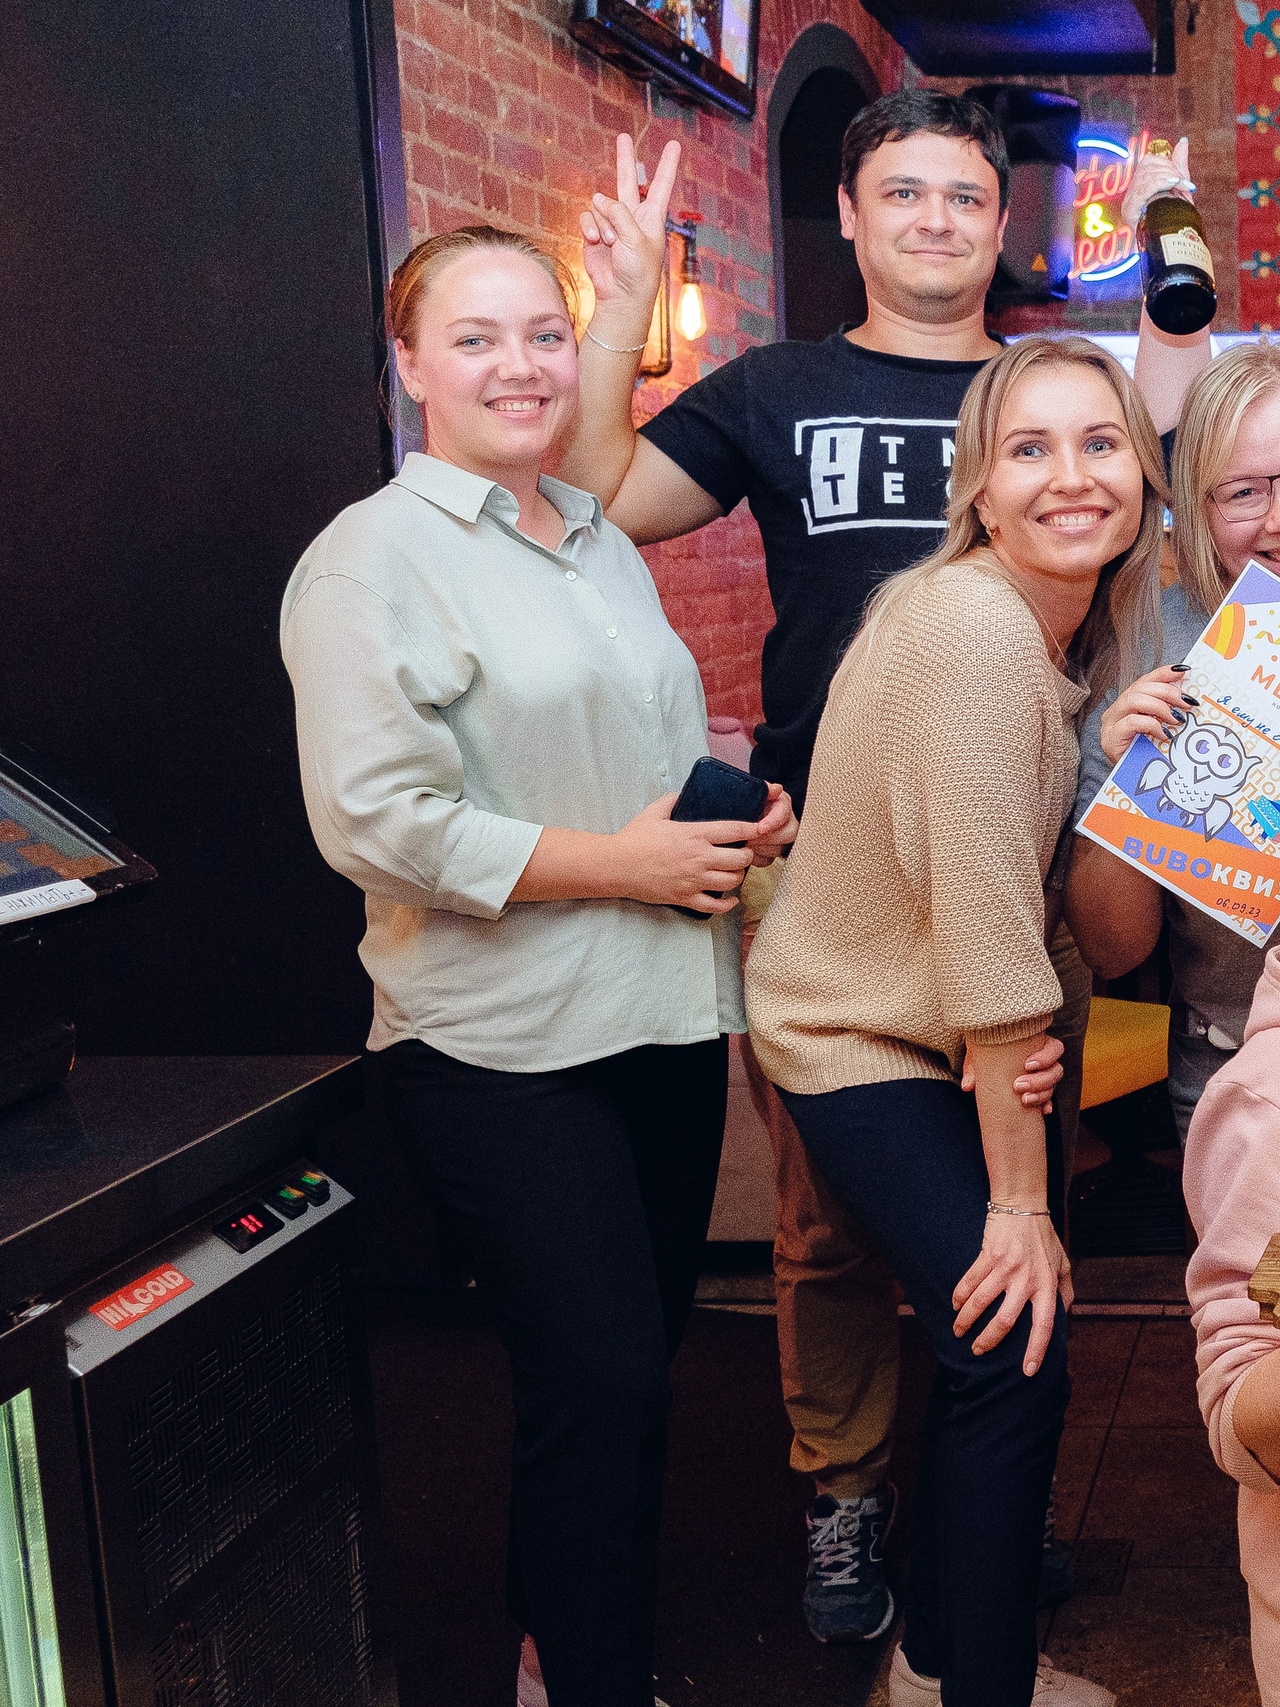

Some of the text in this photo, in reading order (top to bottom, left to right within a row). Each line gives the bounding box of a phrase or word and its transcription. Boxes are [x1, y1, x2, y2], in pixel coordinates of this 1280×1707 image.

[1084, 203, 1114, 237] &
[1216, 695, 1232, 705] Я
[1231, 706, 1255, 728] ему
[1255, 722, 1271, 735] не
[1216, 898, 1261, 918] 06.09.23
